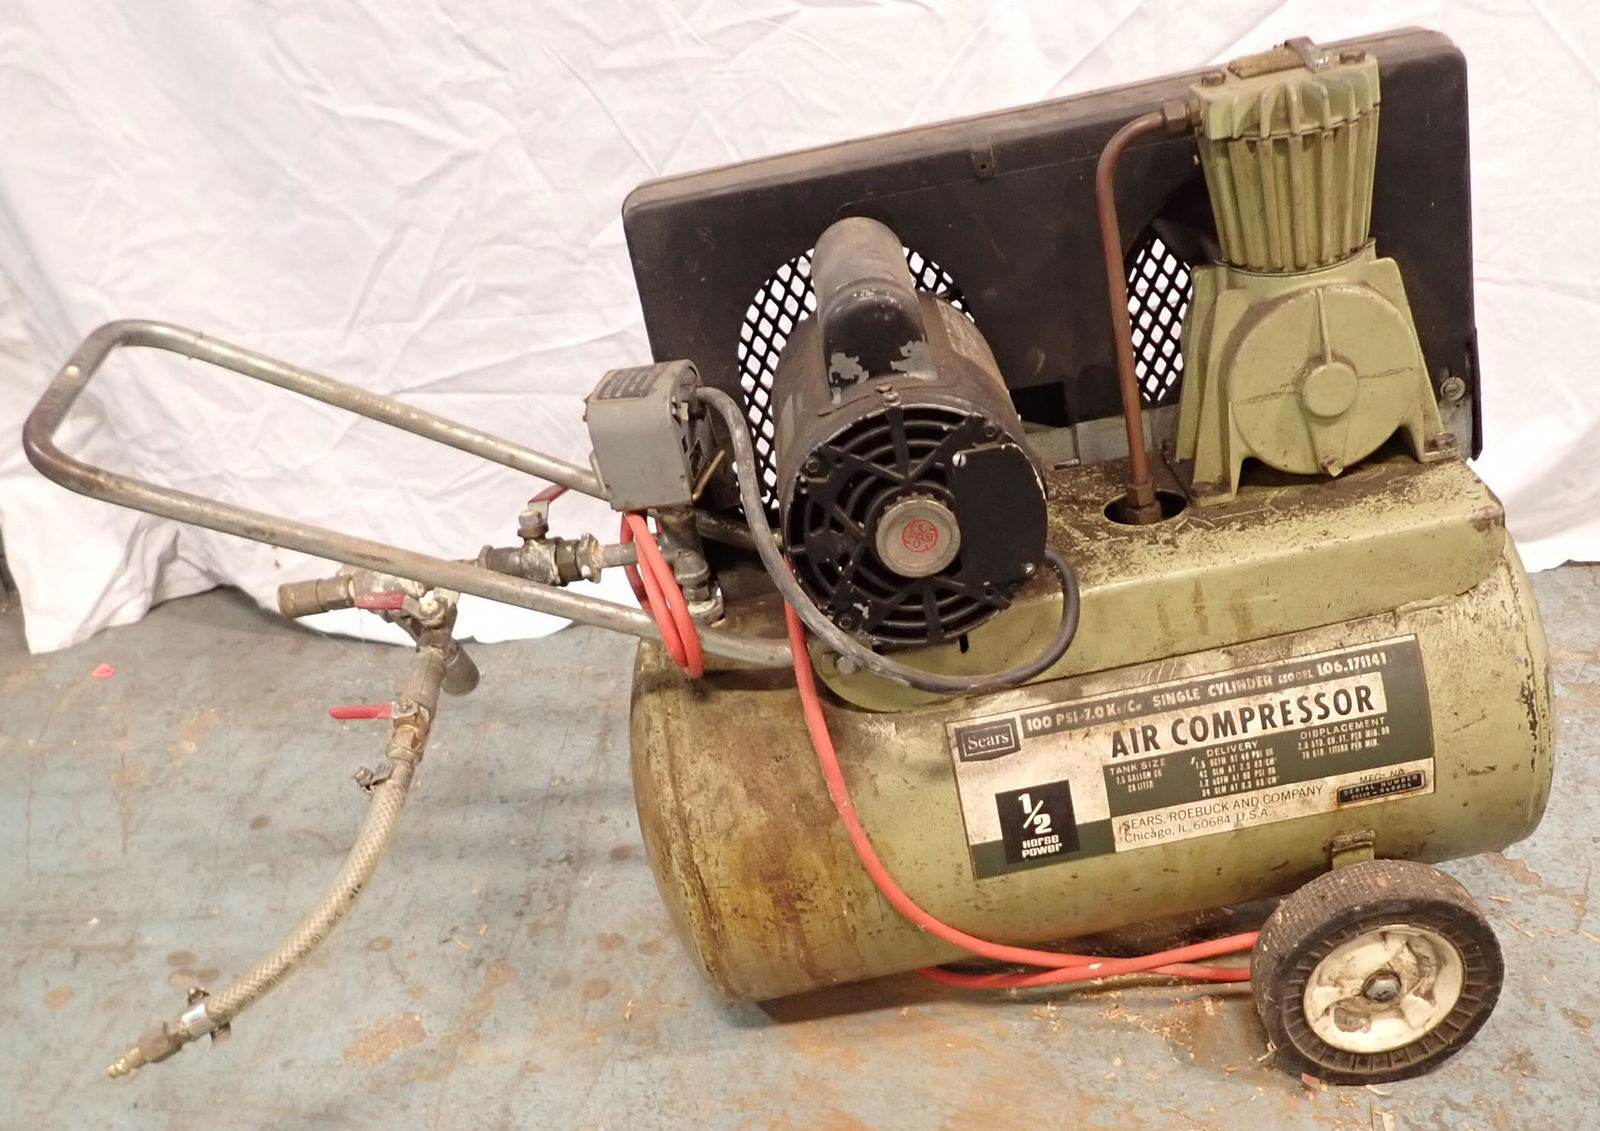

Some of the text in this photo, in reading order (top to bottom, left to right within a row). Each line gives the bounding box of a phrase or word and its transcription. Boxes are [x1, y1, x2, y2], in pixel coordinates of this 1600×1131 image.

[1026, 716, 1052, 731] 100
[1152, 687, 1201, 708] SINGLE
[1207, 675, 1273, 697] CYLINDER
[1112, 685, 1375, 758] AIR COMPRESSOR
[1300, 716, 1385, 740] DISPLACEMENT
[967, 734, 1010, 750] Sears
[1206, 740, 1258, 757] DELIVERY
[1251, 749, 1263, 759] PSI
[1109, 758, 1166, 776] TANK SIZE
[1127, 770, 1152, 783] GALLON
[1169, 800, 1229, 822] ROEBUCK
[1233, 795, 1259, 810] AND
[1262, 785, 1323, 805] COMPANY
[1124, 826, 1175, 844] Chicago,
[1193, 816, 1231, 831] 60684
